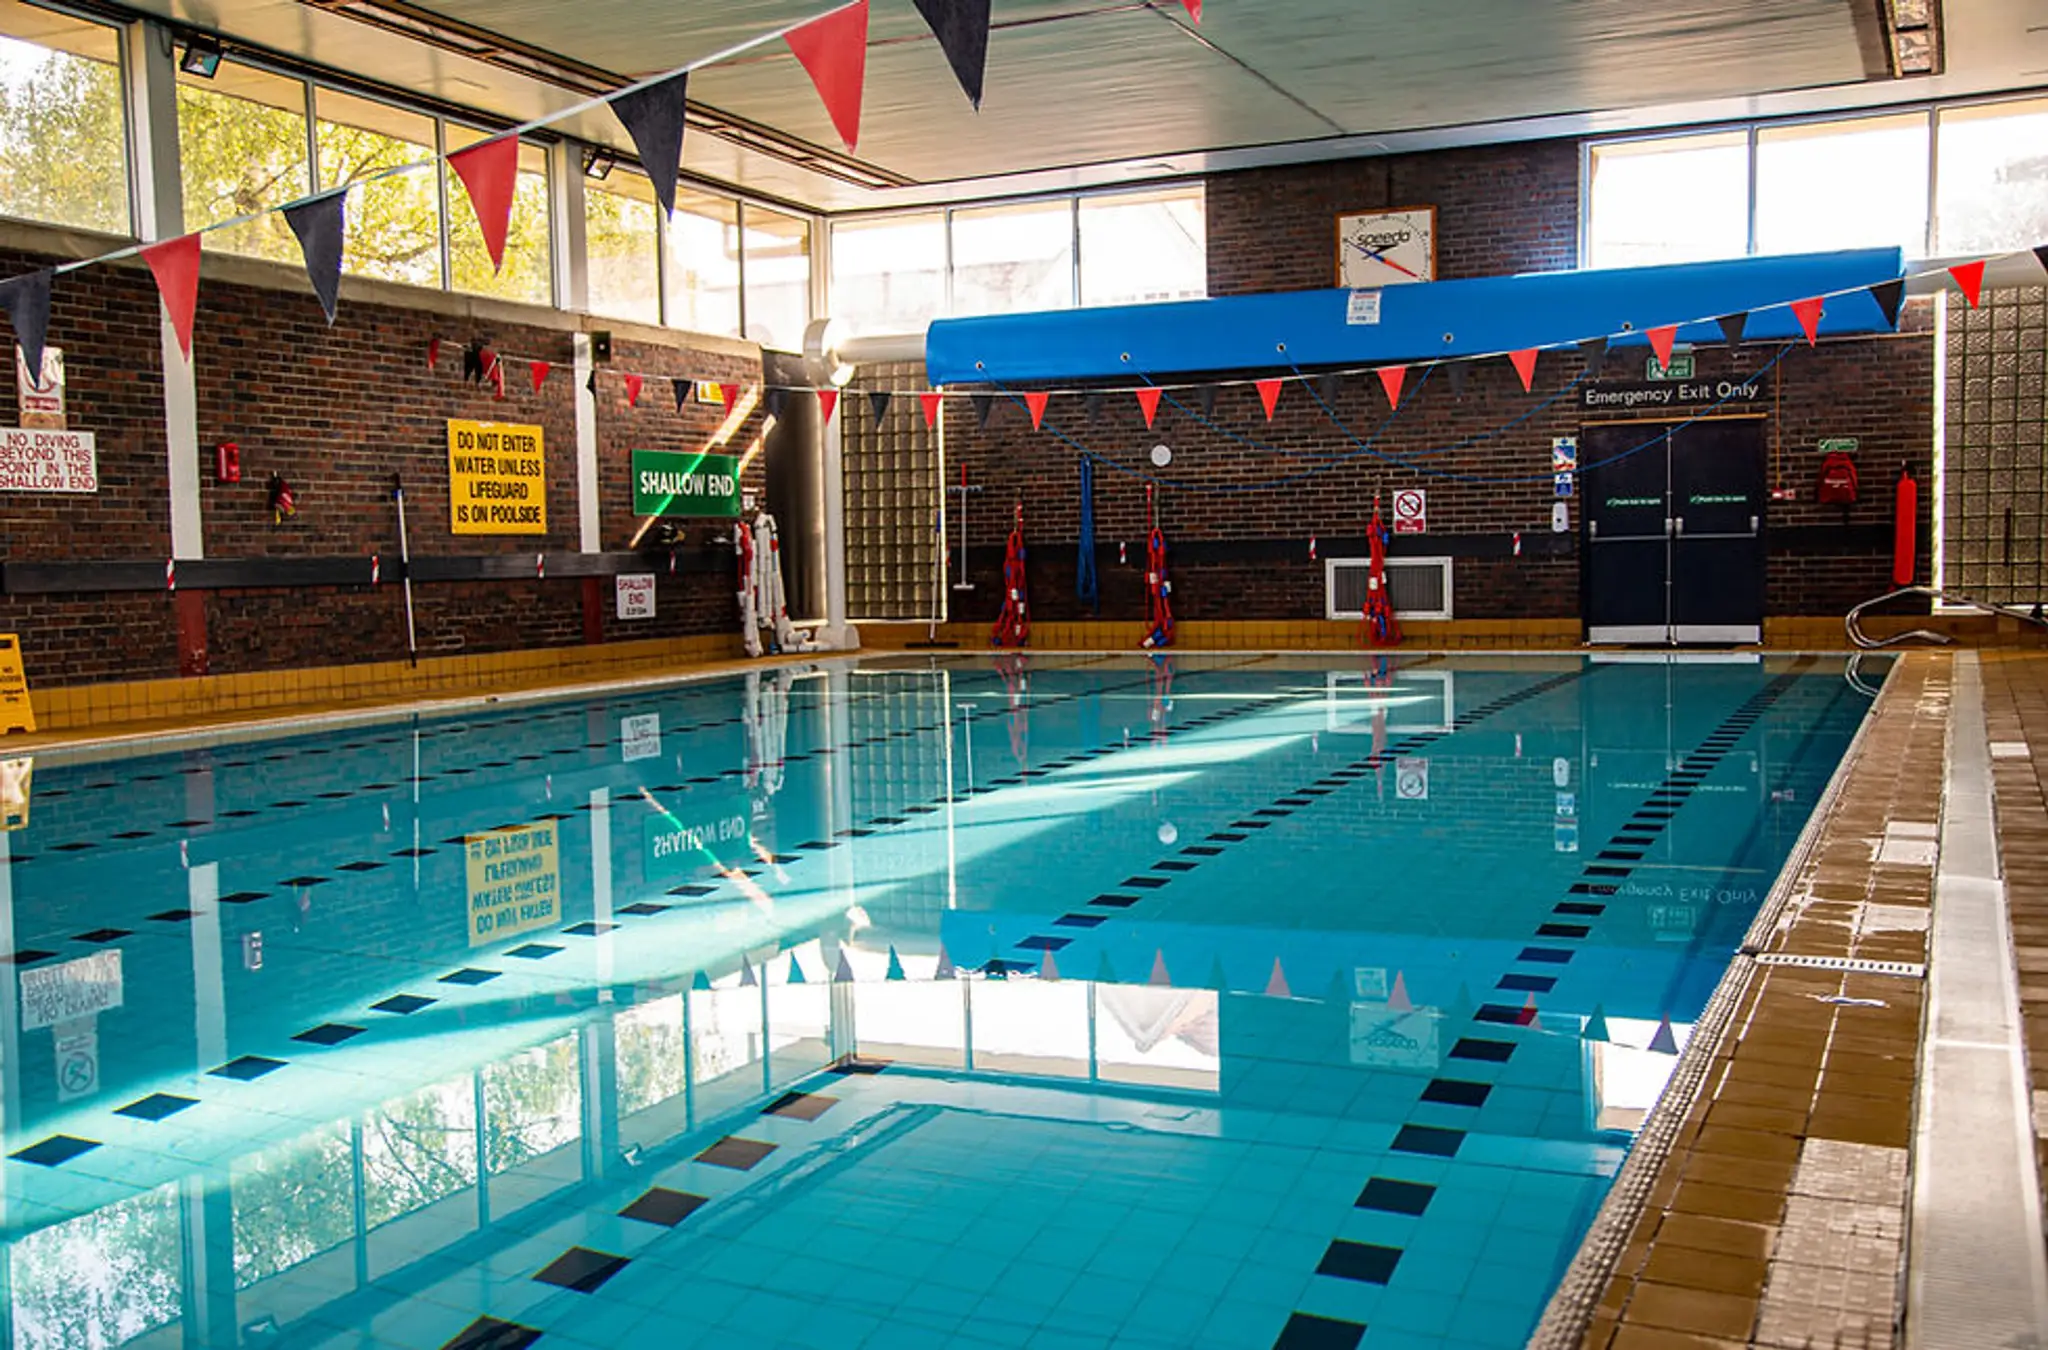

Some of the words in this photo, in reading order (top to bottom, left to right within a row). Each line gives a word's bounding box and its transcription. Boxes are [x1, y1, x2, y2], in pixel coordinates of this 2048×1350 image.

[1358, 229, 1410, 247] speedo
[1585, 388, 1672, 406] Emergency
[1678, 383, 1710, 400] Exit
[1716, 381, 1759, 400] Only
[7, 433, 28, 447] NO
[35, 434, 80, 448] DIVING
[458, 431, 474, 449] DO
[477, 433, 498, 451] NOT
[501, 434, 536, 453] ENTER
[0, 446, 55, 461] BEYOND
[63, 449, 92, 463] THIS
[0, 461, 37, 474] POINT
[46, 463, 60, 474] IN
[66, 463, 92, 475] THE
[454, 456, 496, 475] WATER
[498, 458, 541, 477] UNLESS
[0, 475, 65, 488] SHALLOW
[69, 476, 95, 490] END
[470, 481, 528, 500] LIFEGUARD
[640, 471, 705, 496] SHALLOW
[708, 475, 735, 497] END
[457, 505, 468, 523] IS
[471, 505, 488, 523] ON
[491, 505, 541, 524] POOLSIDE
